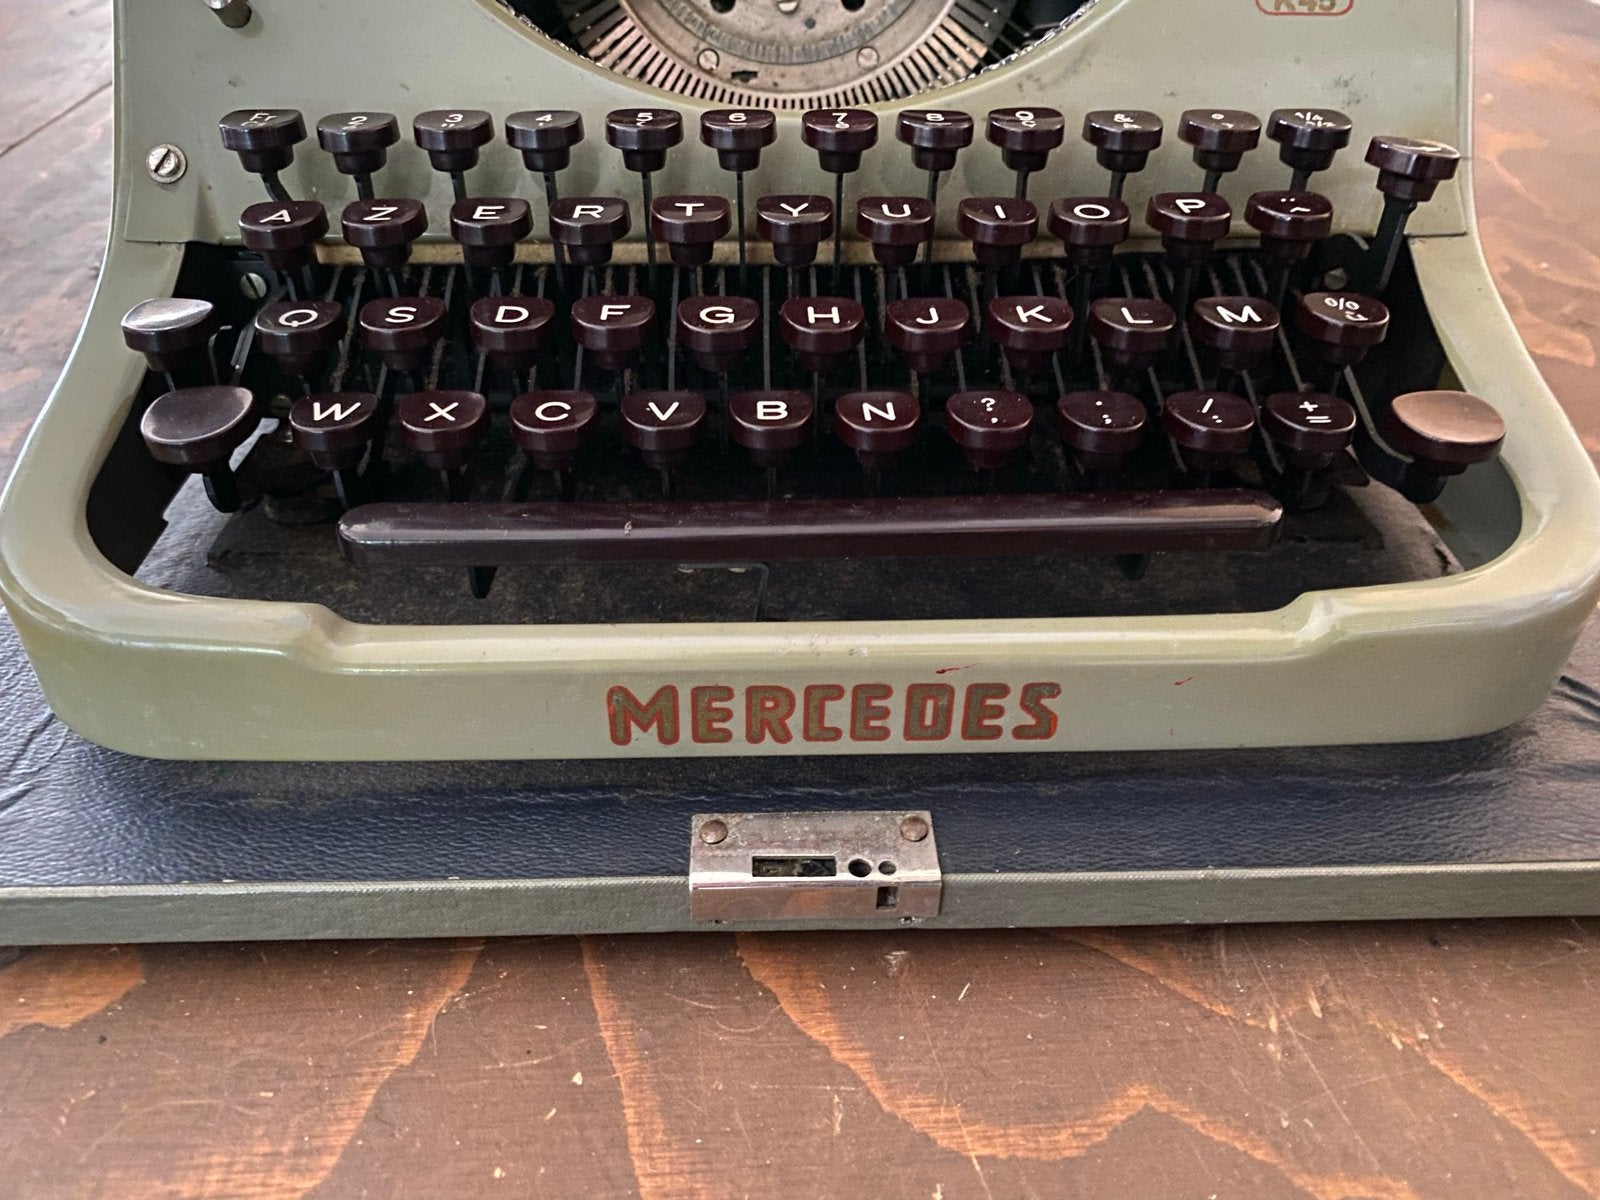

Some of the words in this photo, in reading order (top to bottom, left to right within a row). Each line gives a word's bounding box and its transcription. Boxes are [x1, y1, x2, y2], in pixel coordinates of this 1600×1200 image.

[348, 115, 368, 126] 2
[445, 113, 464, 123] 3
[535, 114, 553, 122] 4
[635, 112, 654, 122] 5
[728, 112, 747, 122] 6
[832, 112, 849, 123] 7
[925, 112, 945, 122] 8
[260, 210, 291, 223] A
[363, 207, 398, 220] Z
[473, 206, 504, 219] E
[573, 205, 604, 218] R
[674, 203, 705, 217] T
[780, 203, 812, 217] Y
[882, 204, 911, 217] U
[995, 205, 1006, 218] I
[1073, 203, 1111, 219] O
[1176, 199, 1205, 213] P
[279, 309, 318, 327] Q
[385, 307, 416, 322] S
[495, 306, 529, 322] D
[600, 305, 631, 320] F
[700, 306, 734, 323] G
[808, 307, 840, 324] H
[916, 308, 938, 324] J
[1016, 305, 1052, 322] K
[1121, 307, 1153, 323] L
[1216, 305, 1262, 323] M
[1325, 298, 1359, 312] %
[313, 402, 361, 421] W
[424, 402, 458, 421] X
[535, 402, 571, 421] C
[648, 402, 680, 421] V
[757, 401, 788, 420] B
[863, 402, 895, 421] N
[981, 398, 995, 411] ?
[606, 682, 1062, 746] MERCEDES
